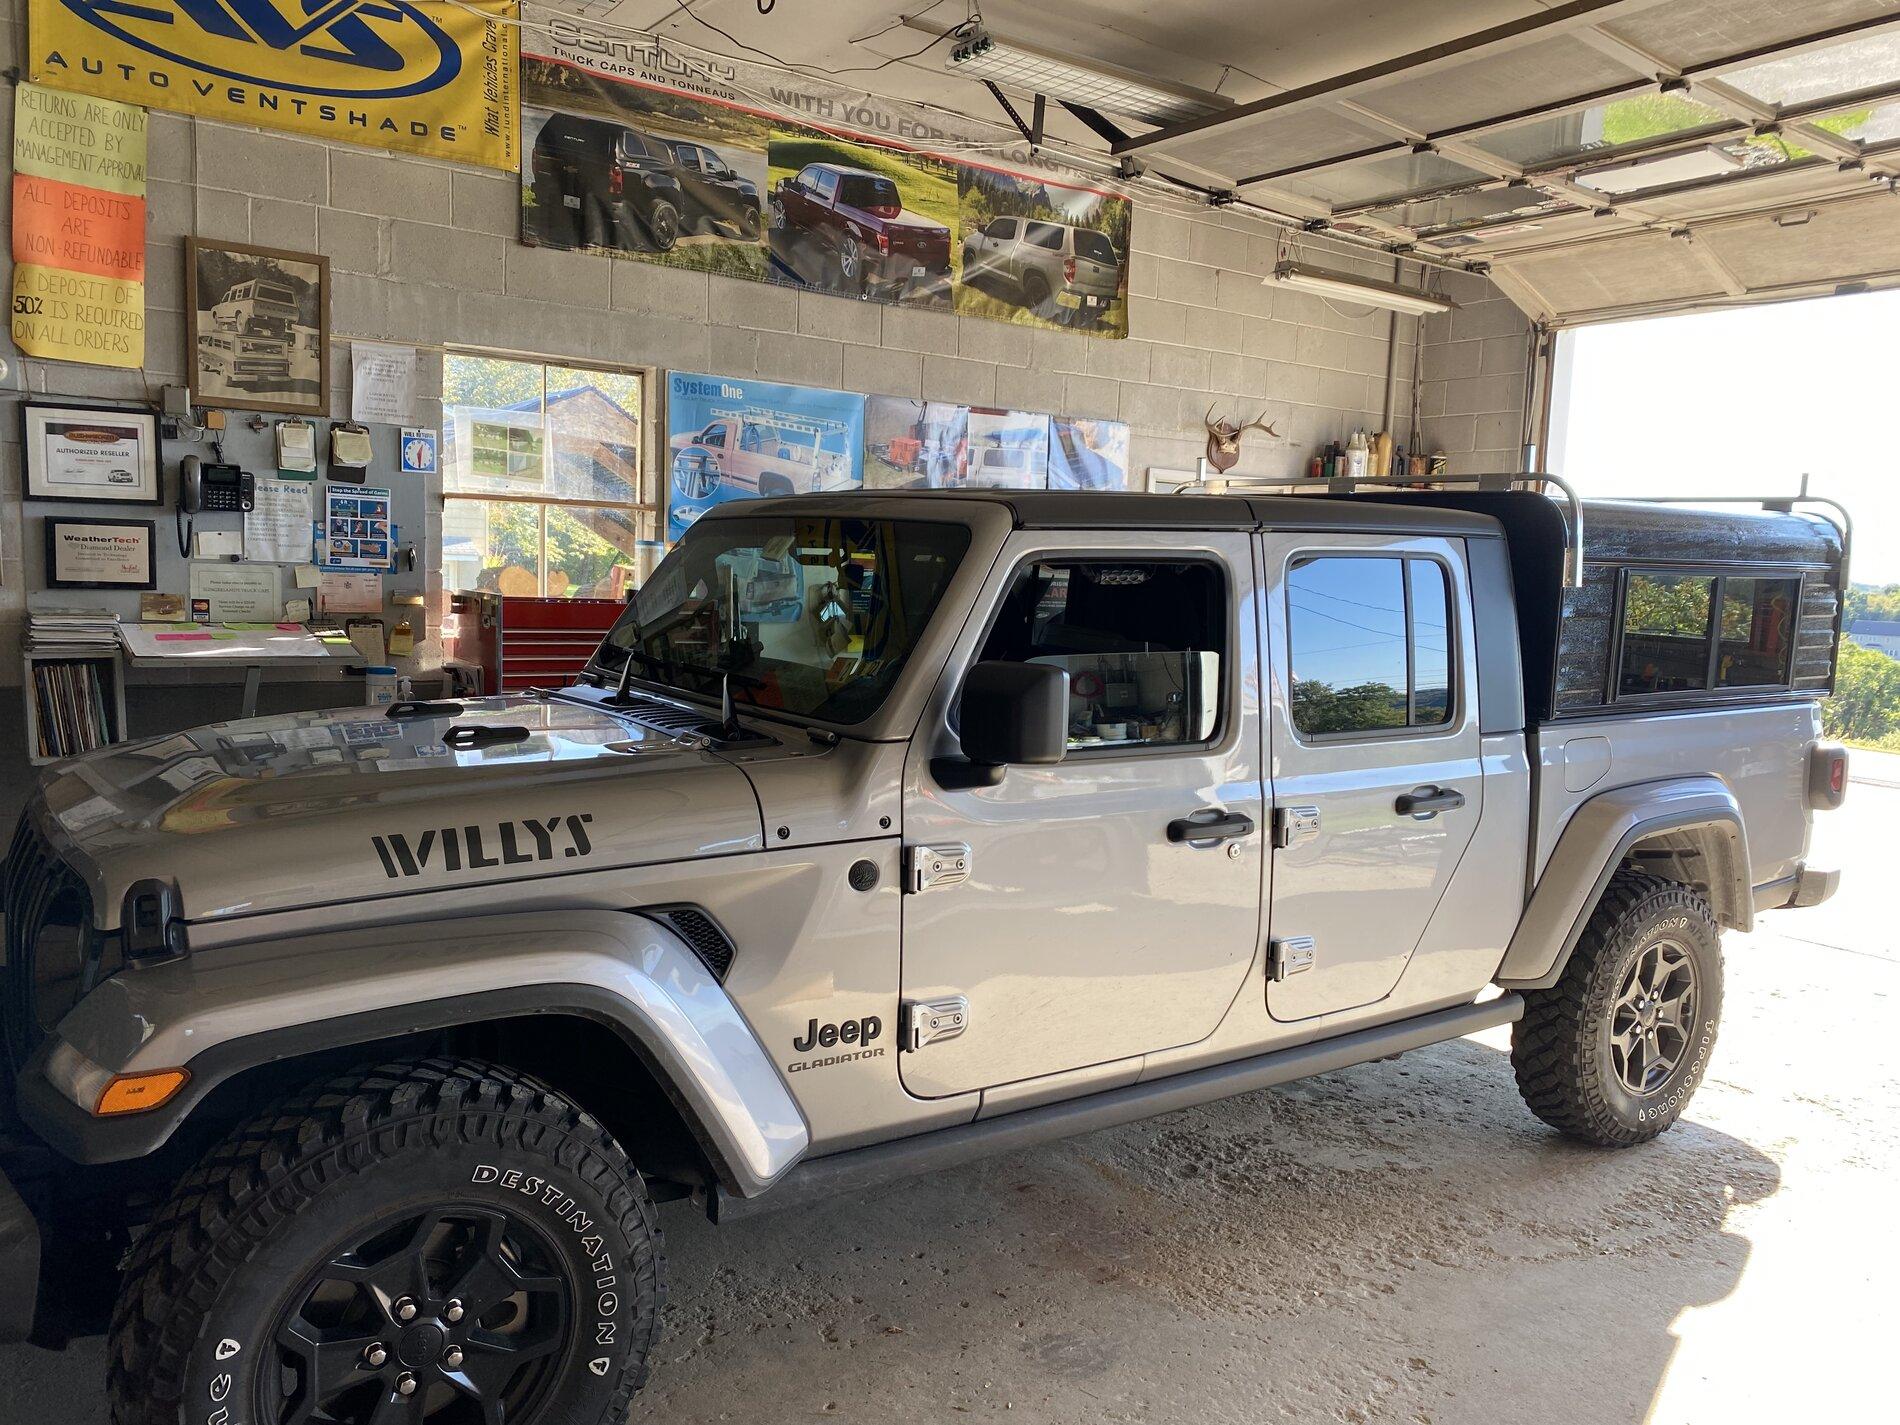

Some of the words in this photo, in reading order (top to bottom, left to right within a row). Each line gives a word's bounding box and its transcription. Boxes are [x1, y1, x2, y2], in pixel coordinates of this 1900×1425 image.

[482, 19, 497, 53] Crave
[550, 19, 735, 86] CENTURY
[483, 55, 498, 103] Vehicles
[501, 8, 511, 158] www.lundinternational.cm
[552, 46, 594, 67] TRUCK
[600, 61, 635, 76] CAPS
[640, 71, 665, 84] AND
[671, 78, 735, 101] TONNEAUS
[21, 89, 77, 118] RETURNS
[84, 103, 110, 125] ARE
[113, 110, 147, 132] ONLY
[46, 51, 169, 88] AUTO
[192, 79, 456, 142] VENTSHADE
[769, 87, 834, 117] WITH
[842, 103, 890, 130] YOU
[29, 117, 96, 147] ACCEPTED
[105, 133, 125, 153] BY
[485, 107, 499, 138] What
[15, 138, 98, 172] MANAGEMENT
[97, 158, 147, 182] APPROVAL
[23, 183, 52, 205] ALL
[64, 190, 131, 220] DEPOSITS
[61, 217, 93, 238] ARE
[16, 271, 29, 289] A
[38, 273, 108, 301] DEPOSIT
[114, 286, 137, 304] OF
[13, 295, 43, 315] 50%
[49, 300, 69, 320] IS
[75, 303, 144, 330] REQUIRED
[14, 321, 35, 340] ON
[39, 324, 69, 345] ALL
[74, 329, 129, 353] ORDERS
[255, 483, 279, 492] lease
[283, 484, 308, 494] Read
[64, 535, 140, 543] WeatherTech
[371, 813, 593, 878] WILLYS
[1607, 917, 1679, 1019] DESTINATION
[793, 1016, 882, 1052] Jeep
[787, 1048, 885, 1073] GLADIATOR
[1648, 1020, 1715, 1120] FIRESTONE
[472, 1165, 618, 1345] DESTINATION
